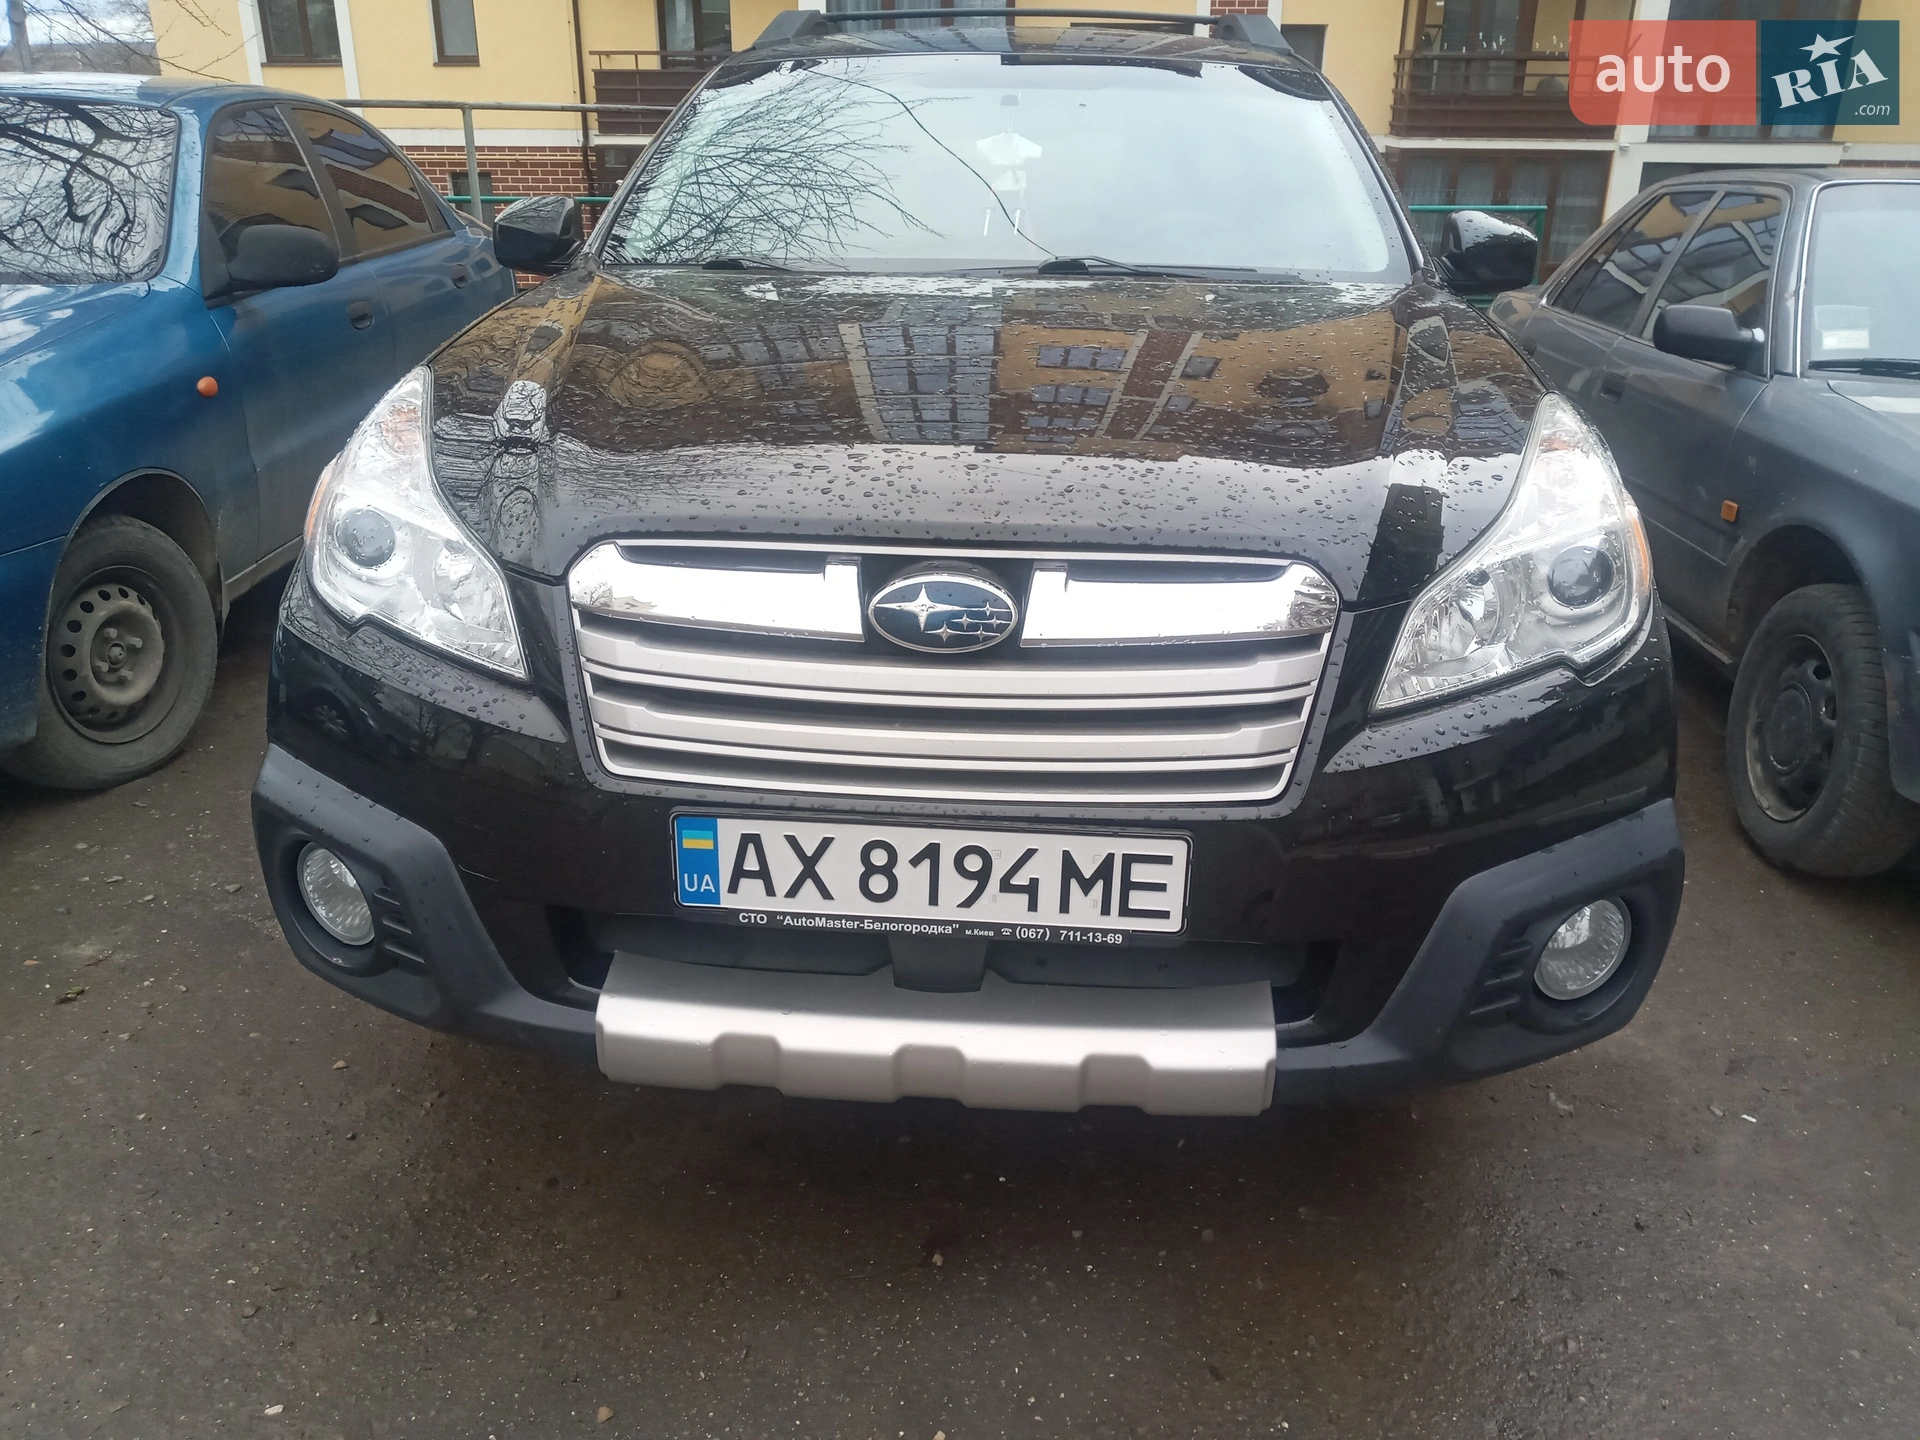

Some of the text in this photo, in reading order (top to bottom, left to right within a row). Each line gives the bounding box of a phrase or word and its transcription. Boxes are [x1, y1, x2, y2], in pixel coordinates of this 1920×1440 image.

[684, 873, 716, 893] UA
[727, 832, 1173, 919] AX 8194 ME
[738, 912, 768, 924] СТО
[965, 928, 995, 937] м.Киев
[1016, 926, 1051, 941] (067)
[1060, 930, 1123, 944] 711-13-69
